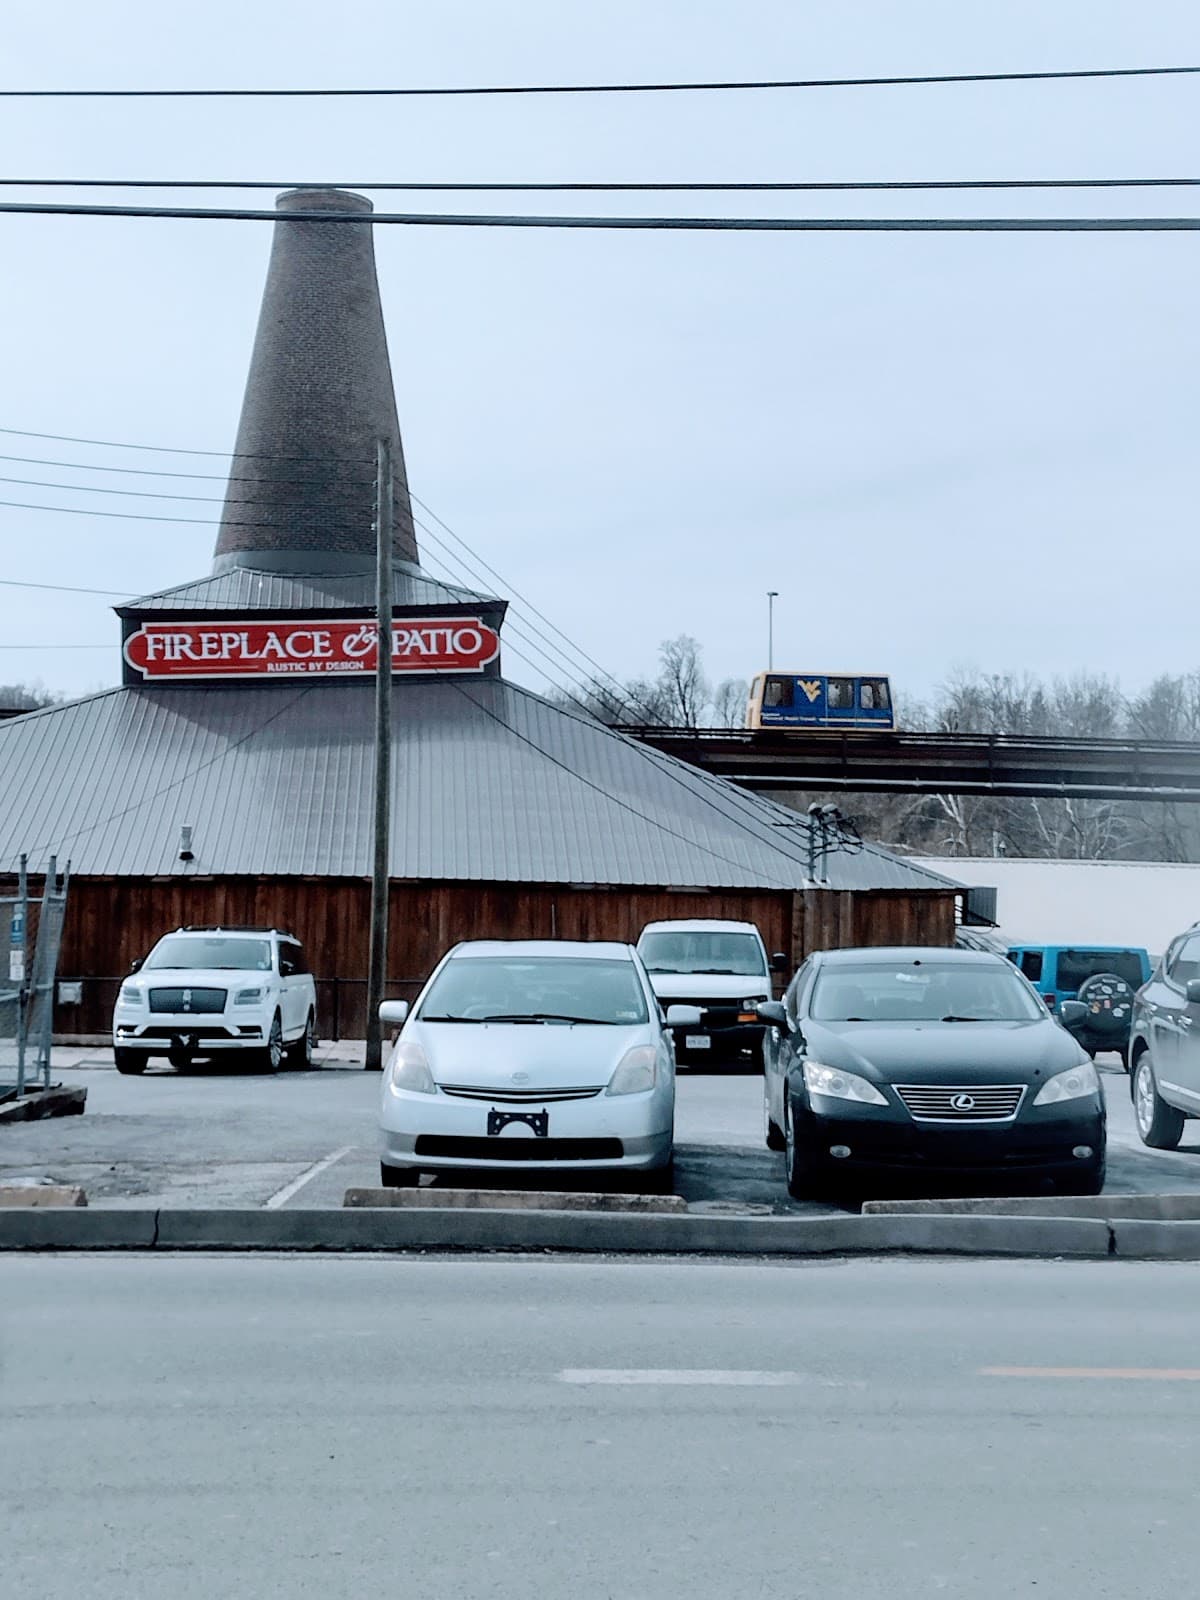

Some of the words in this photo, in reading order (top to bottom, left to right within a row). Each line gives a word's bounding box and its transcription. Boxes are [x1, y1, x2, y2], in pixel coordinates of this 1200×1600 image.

[144, 629, 334, 660] FIREPLACE
[342, 625, 379, 657] &
[391, 628, 483, 656] PATIO
[267, 661, 306, 672] RUSTIC
[308, 661, 324, 672] BY
[325, 660, 365, 671] DESIGN
